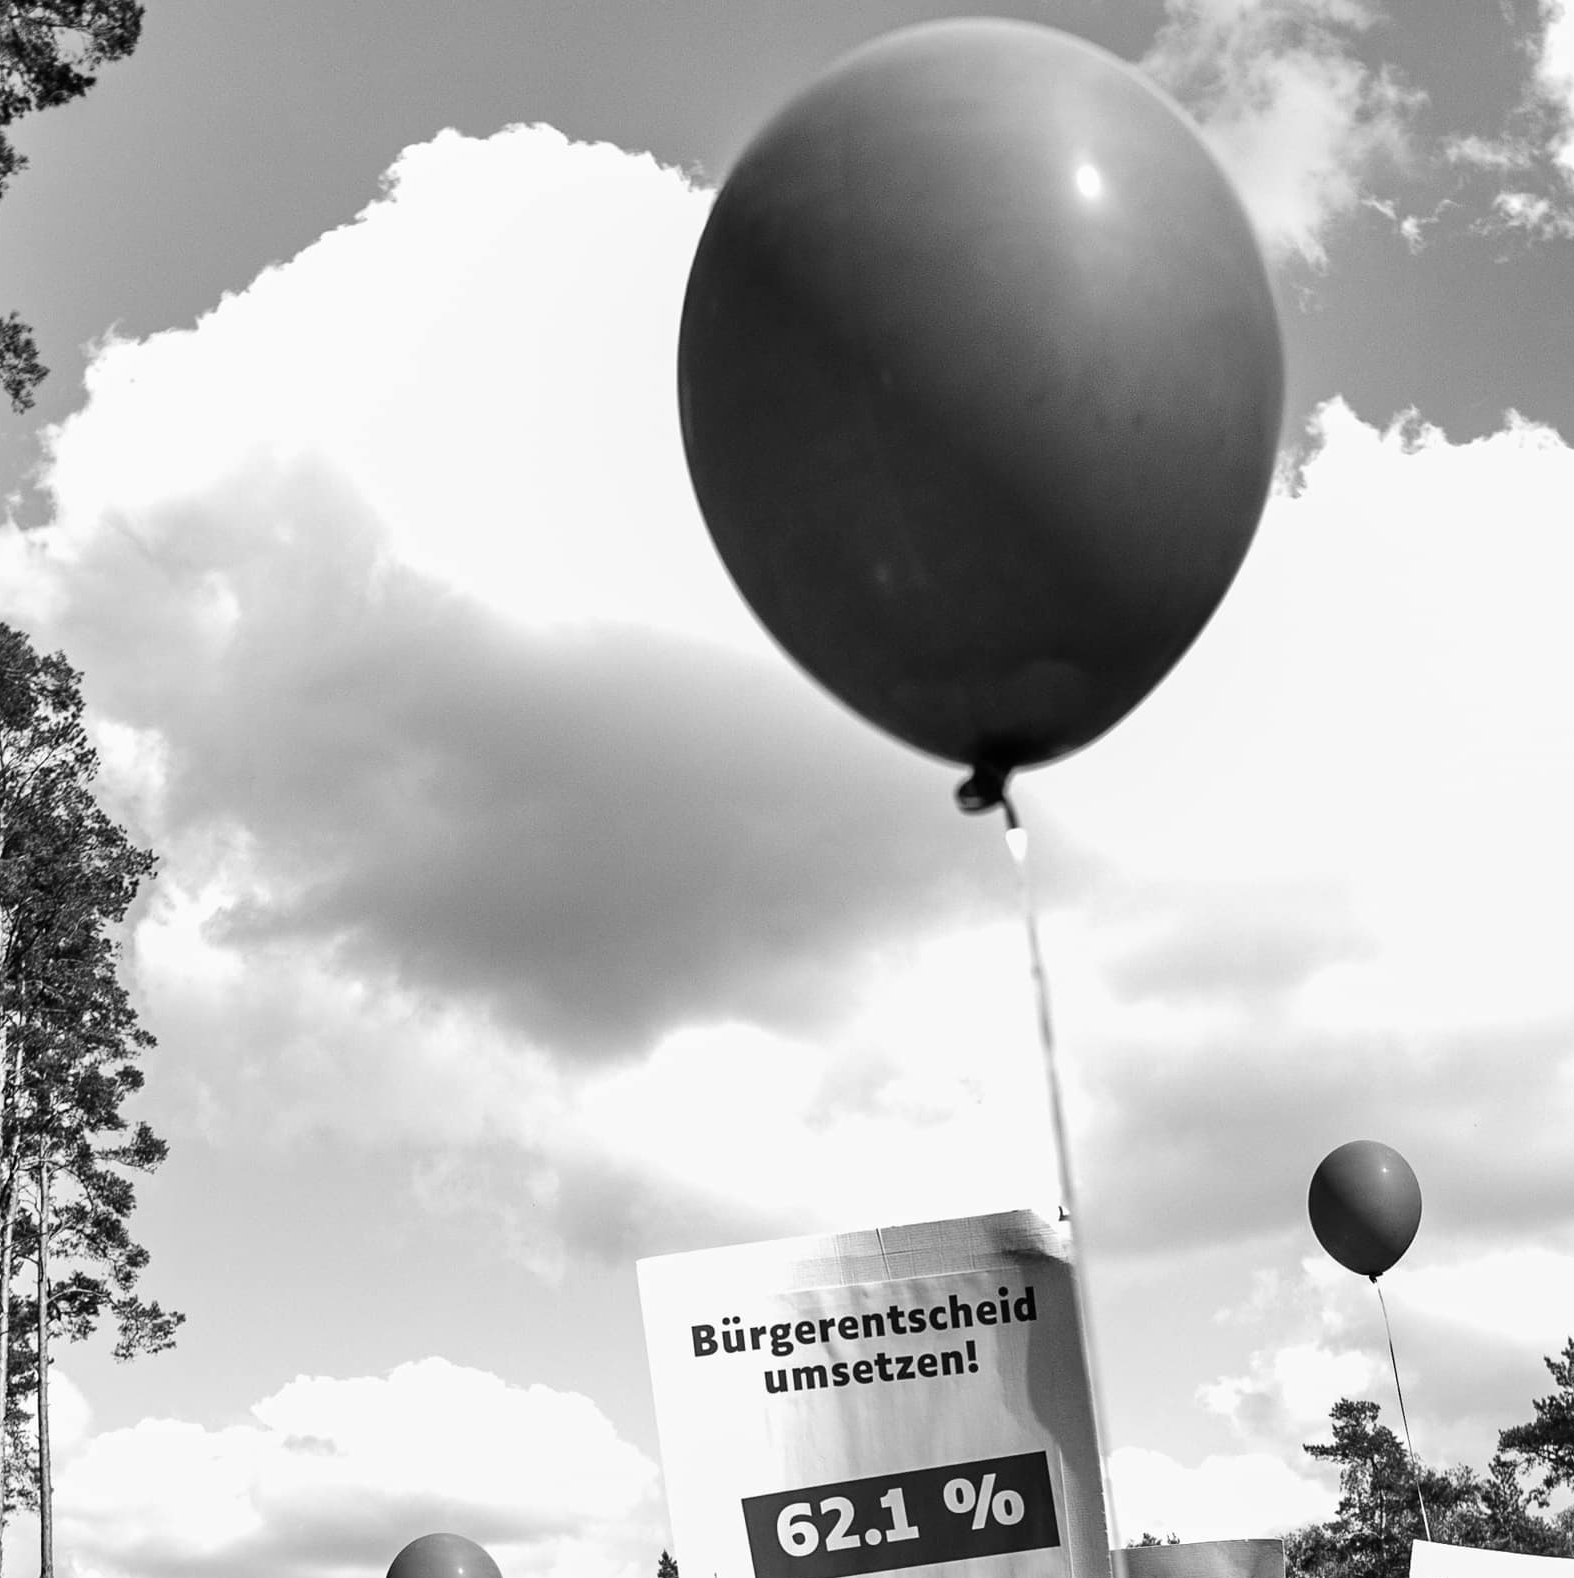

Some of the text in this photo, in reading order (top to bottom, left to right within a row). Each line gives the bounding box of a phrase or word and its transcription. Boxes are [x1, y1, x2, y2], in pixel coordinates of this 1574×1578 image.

[691, 1286, 1037, 1357] Bürgerentscheid
[764, 1340, 979, 1394] umsetzen!
[776, 1473, 1025, 1557] 62.1 %
